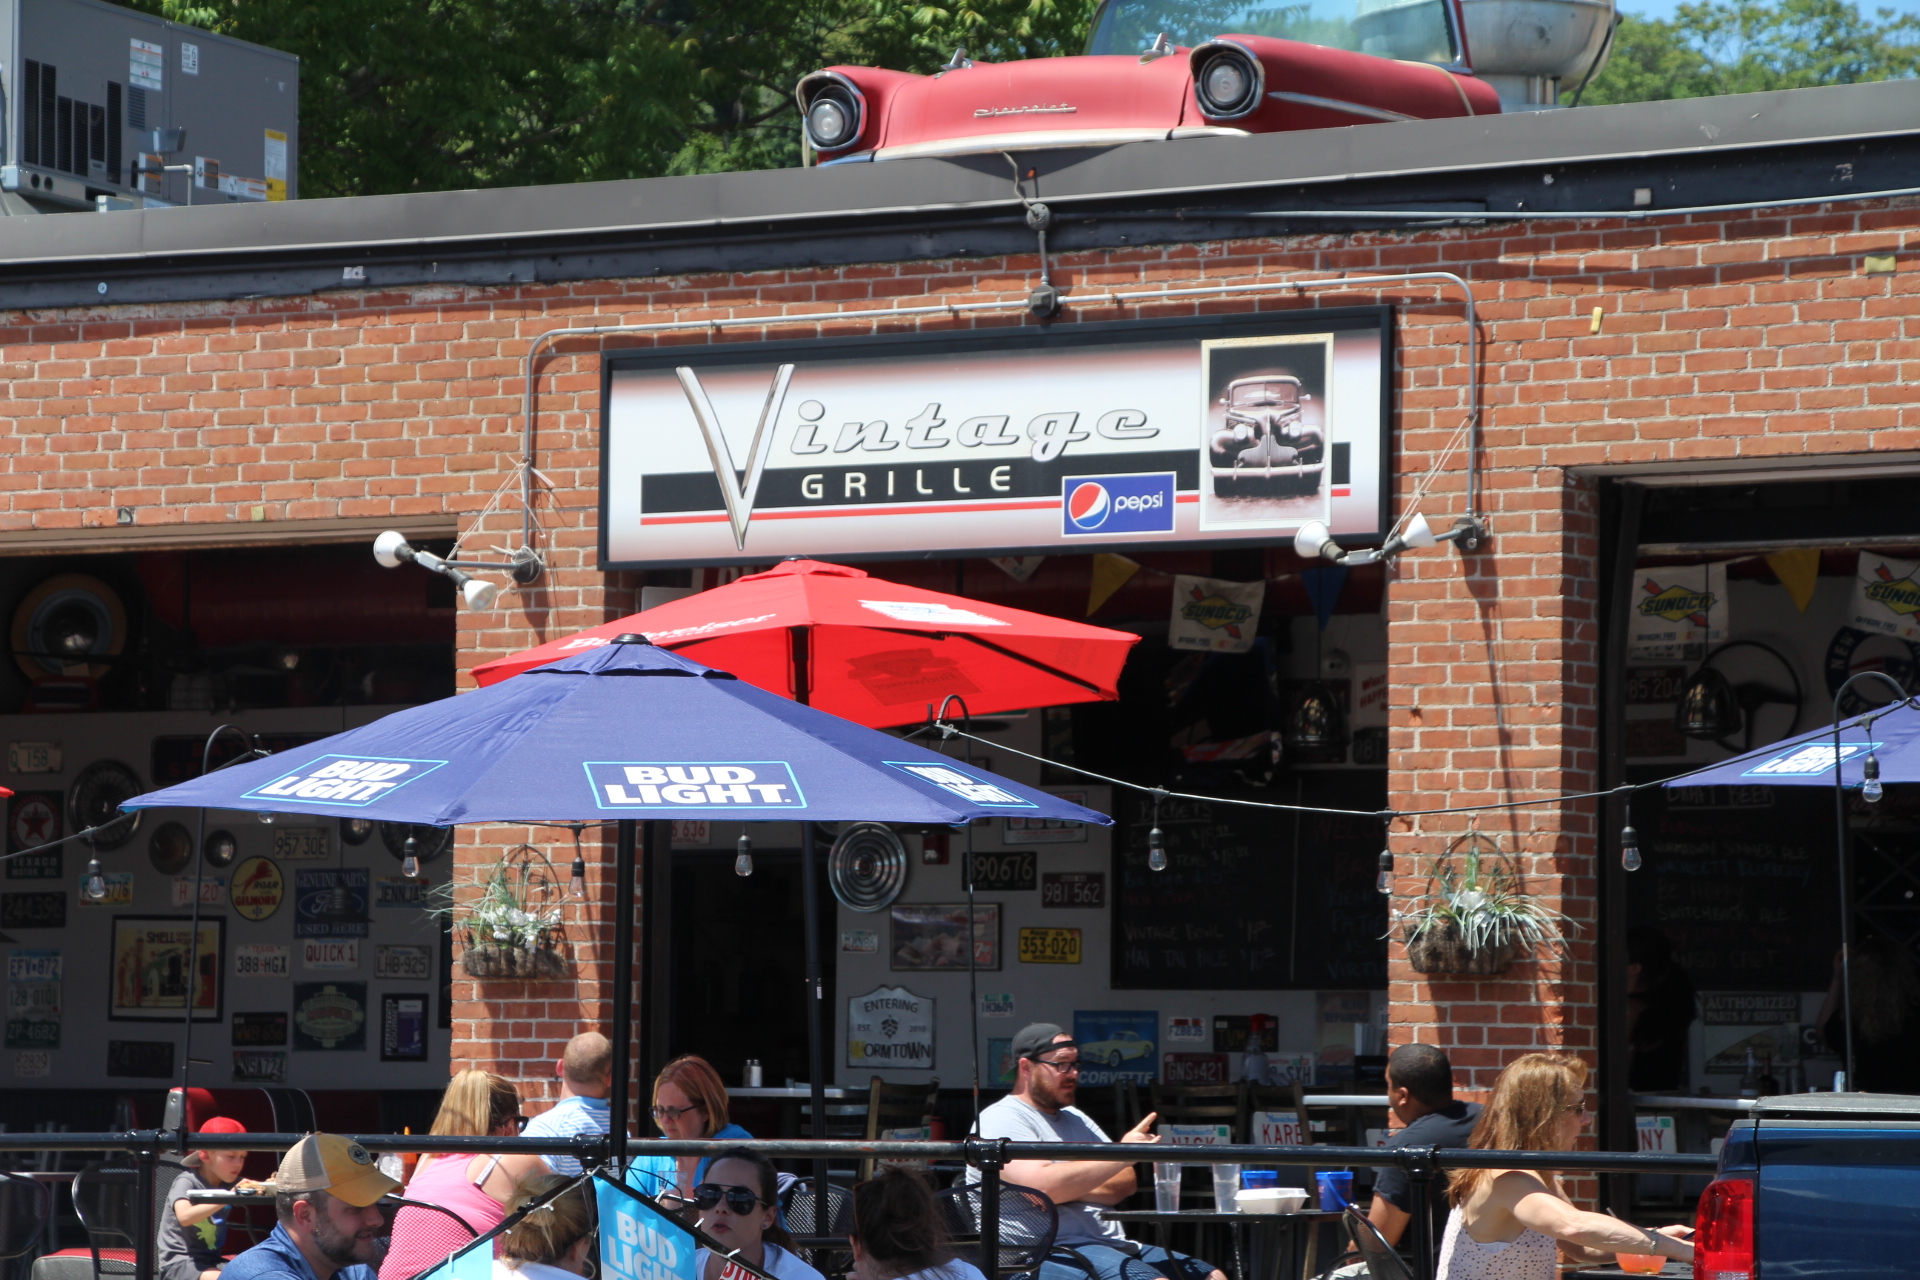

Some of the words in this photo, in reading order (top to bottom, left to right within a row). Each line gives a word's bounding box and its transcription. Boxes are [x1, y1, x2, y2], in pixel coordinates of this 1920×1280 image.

[676, 363, 1161, 552] Vintage
[801, 464, 1012, 501] GRILLE
[1113, 490, 1164, 516] pepsi
[1186, 604, 1248, 620] SUNOCO
[1644, 597, 1710, 613] SUNOCO
[1788, 746, 1859, 760] BUD
[309, 760, 411, 780] BUD
[623, 766, 757, 784] BUD
[904, 766, 974, 785] BUD
[604, 784, 788, 804] LIGHT
[12, 856, 57, 867] TEXACO
[12, 867, 38, 877] MOTOR
[44, 867, 57, 877] OIL
[296, 872, 336, 888] GENUINE
[342, 872, 367, 887] PARTS
[253, 881, 279, 889] ROAR
[235, 895, 278, 906] GILMORE
[296, 923, 329, 935] USED
[332, 922, 364, 934] HERE
[146, 931, 176, 945] SHELL
[252, 945, 276, 953] TEXAS
[305, 944, 345, 962] QUICK
[348, 944, 356, 962] 1
[863, 998, 919, 1014] ENTERING
[1707, 996, 1797, 1010] AUTHORIZED
[1706, 1011, 1739, 1022] PARTS
[1743, 1011, 1751, 1022] &
[1754, 1011, 1797, 1022] SERVICE
[857, 1024, 872, 1032] EST.
[908, 1025, 927, 1033] 2010
[850, 1040, 932, 1060] WORMTOWN
[1078, 1070, 1155, 1085] CORVETTE
[616, 1210, 677, 1269] BUD
